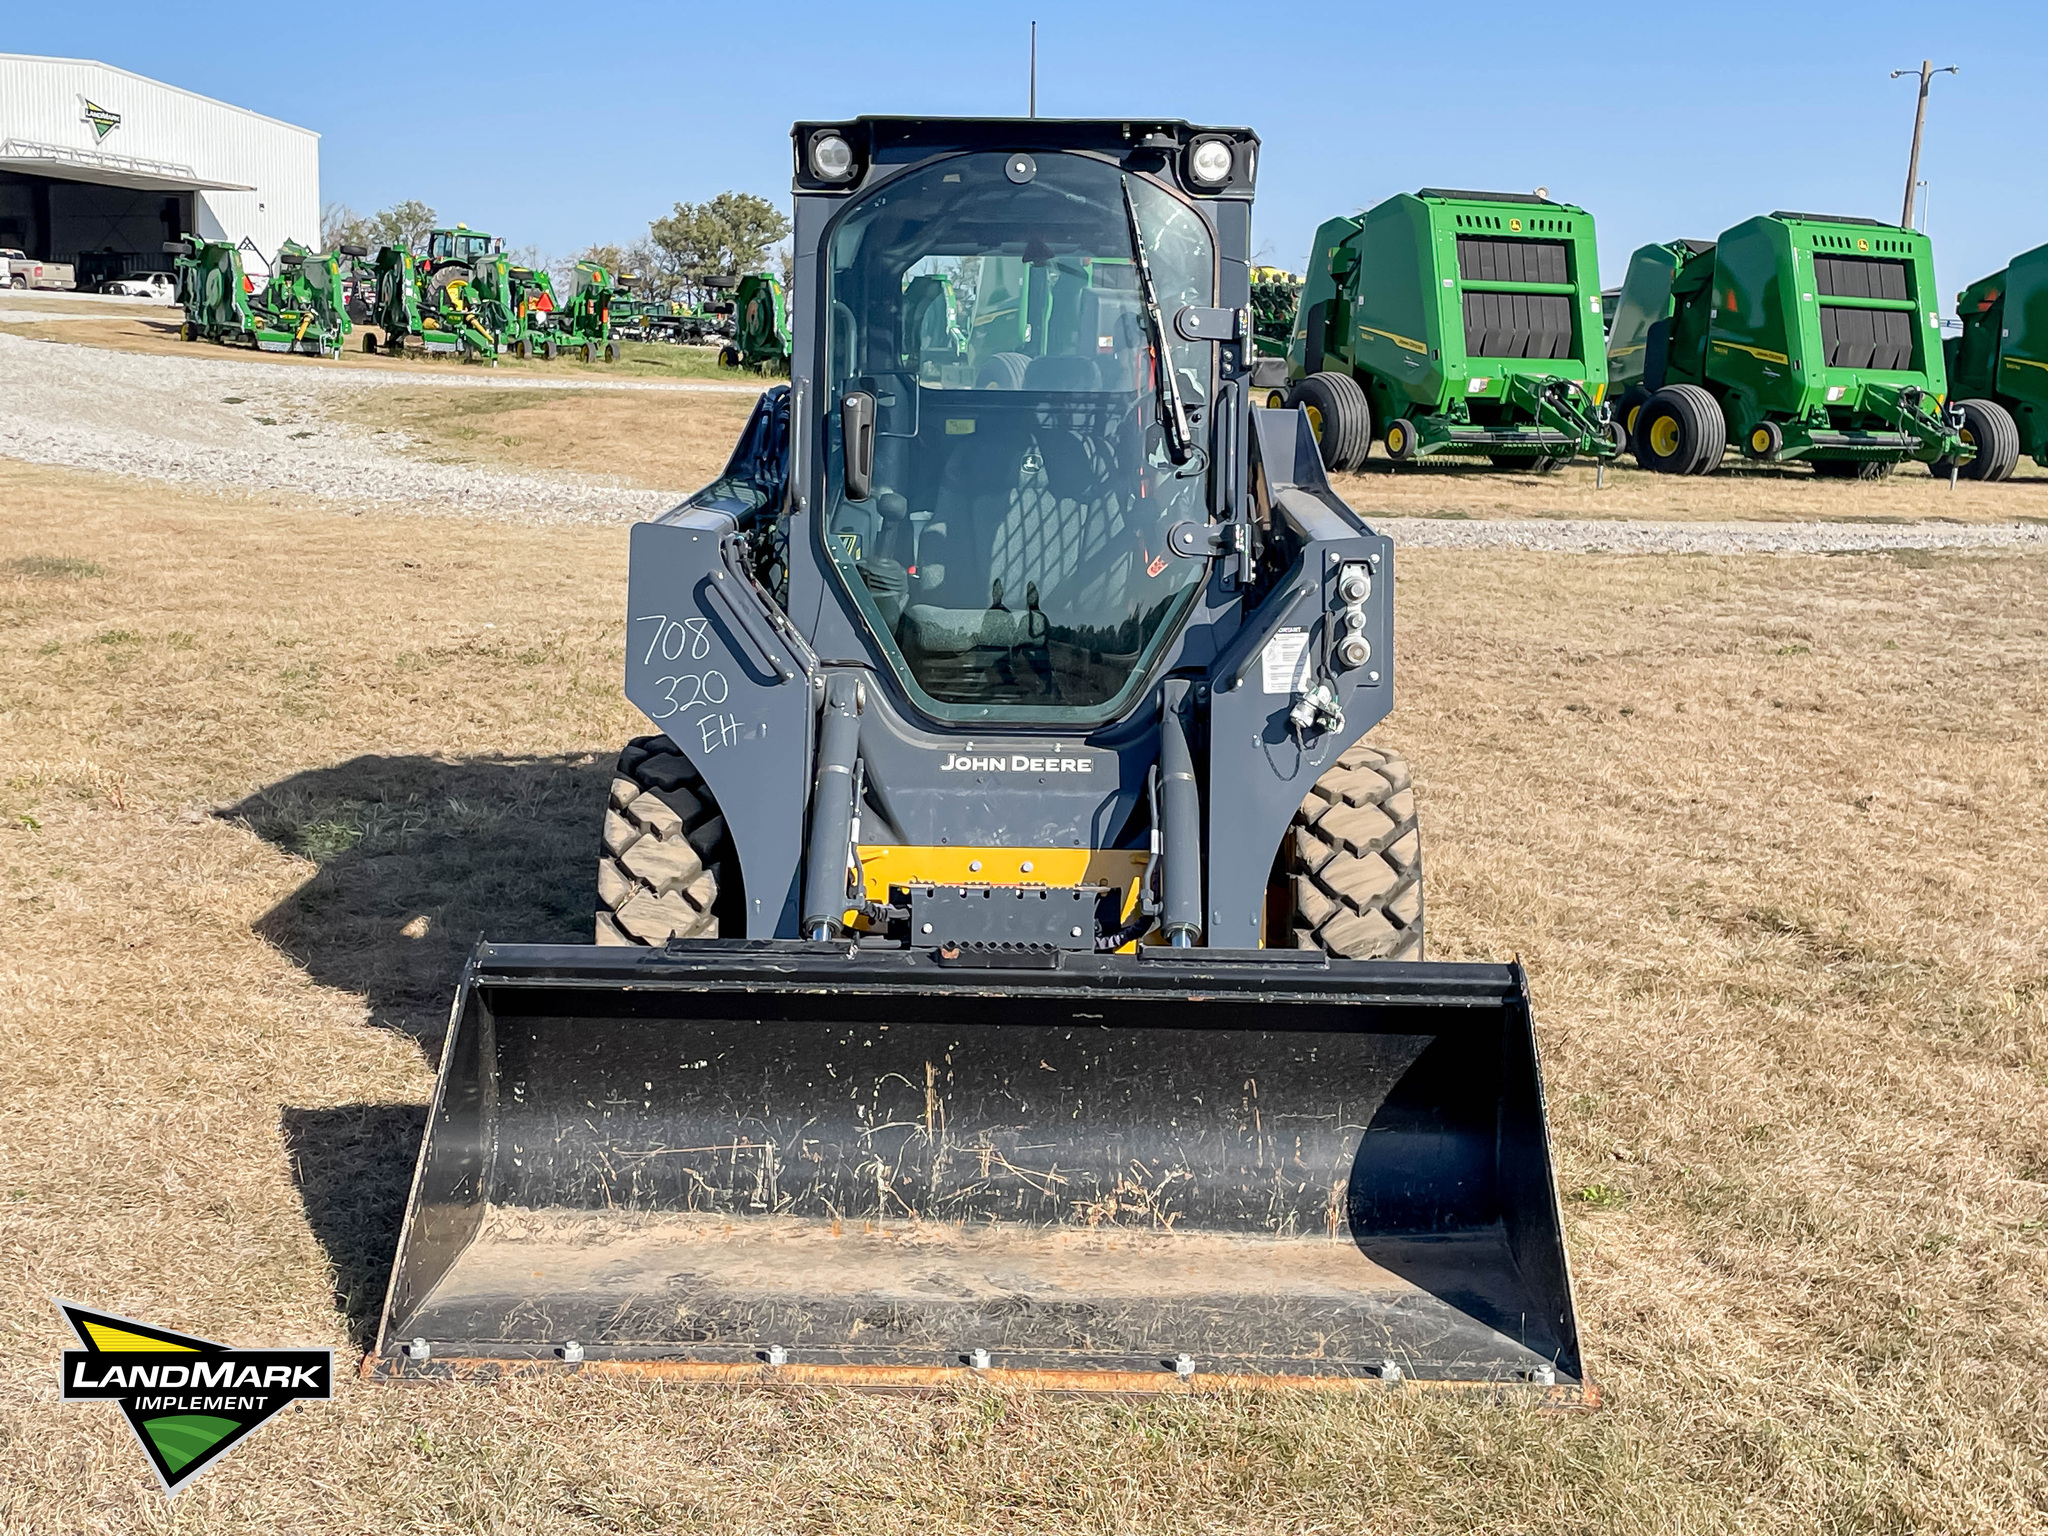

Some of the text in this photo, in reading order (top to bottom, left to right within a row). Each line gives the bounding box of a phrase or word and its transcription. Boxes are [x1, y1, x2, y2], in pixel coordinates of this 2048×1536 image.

[636, 615, 713, 665] 708
[652, 670, 729, 719] 320
[696, 713, 745, 754] EH
[940, 753, 1093, 773] JOHN DEERE
